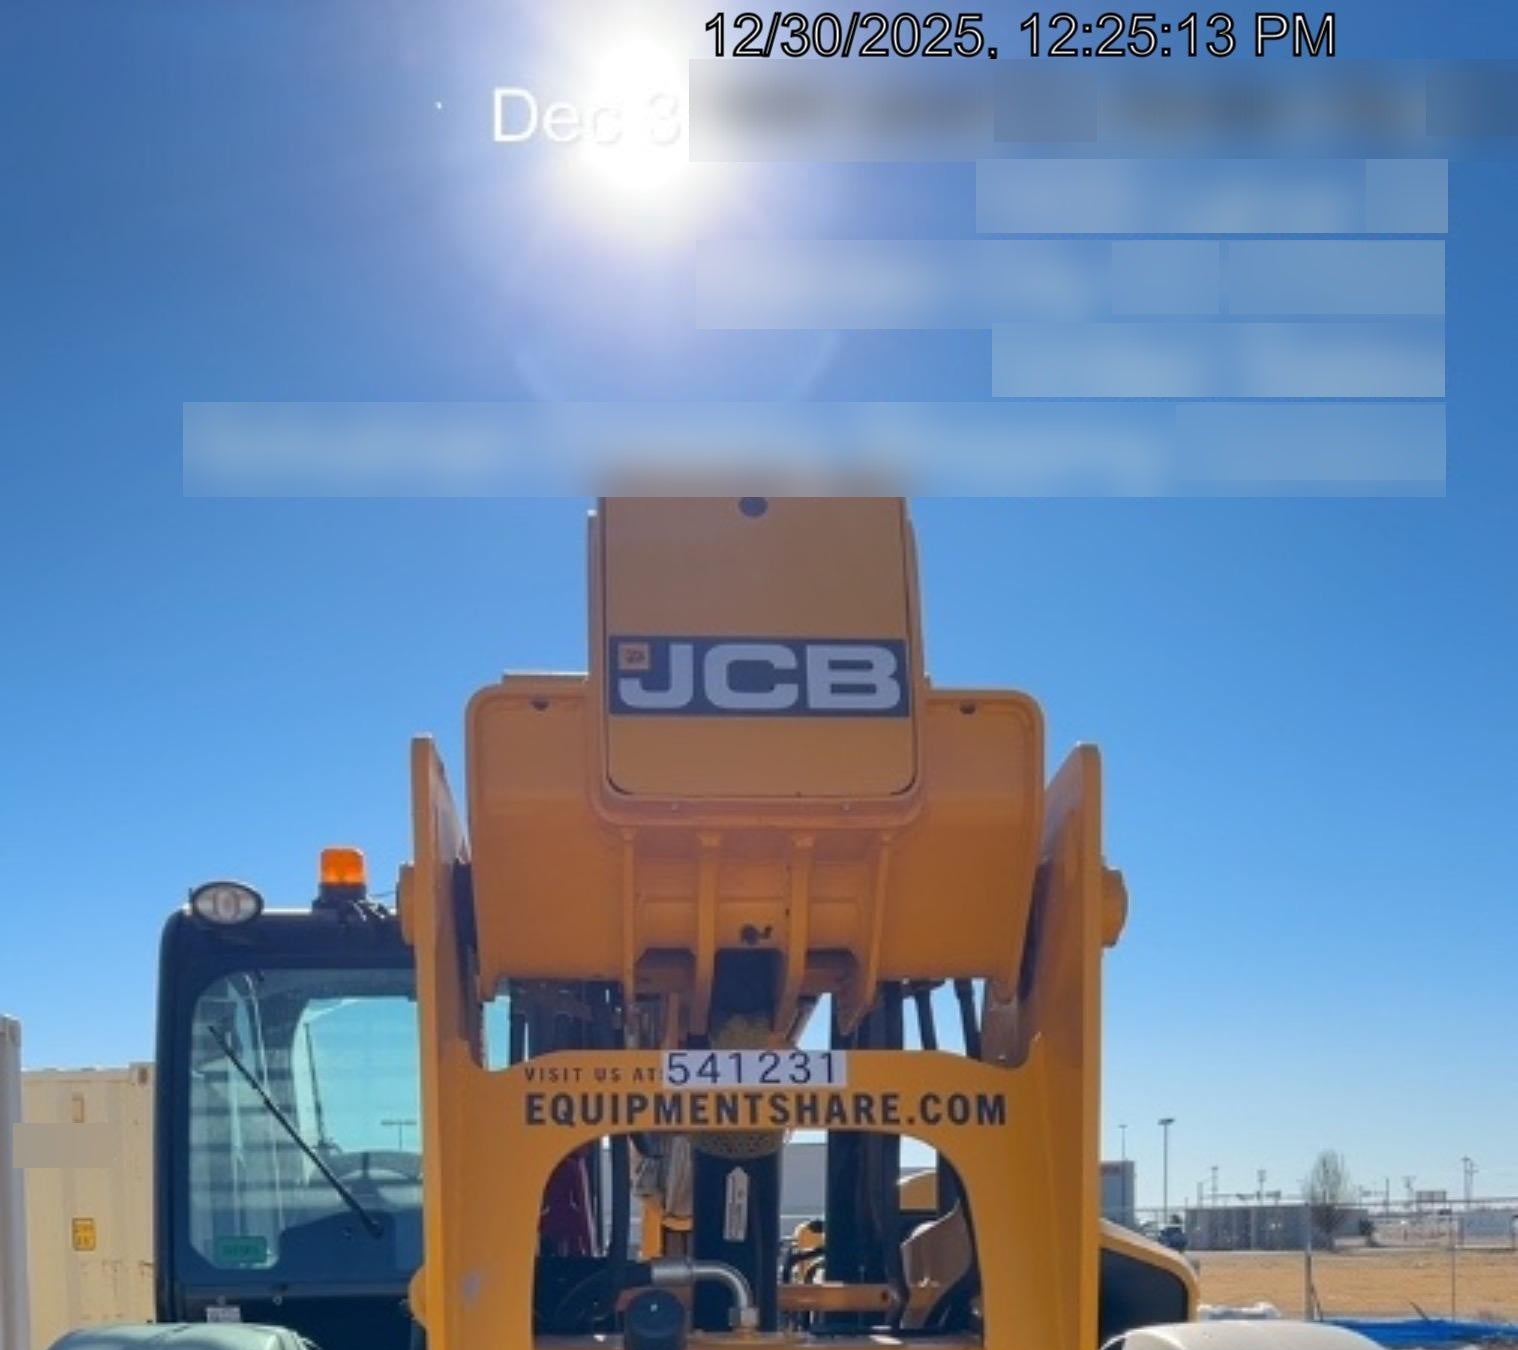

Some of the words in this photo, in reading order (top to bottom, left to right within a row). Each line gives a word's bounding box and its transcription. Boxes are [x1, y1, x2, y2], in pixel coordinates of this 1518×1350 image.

[617, 643, 901, 710] JCB
[523, 1066, 582, 1082] VISIT
[595, 1066, 621, 1082] US
[667, 1051, 836, 1085] 541231
[525, 1091, 1007, 1127] EQUIPMENTSHARE.COM
